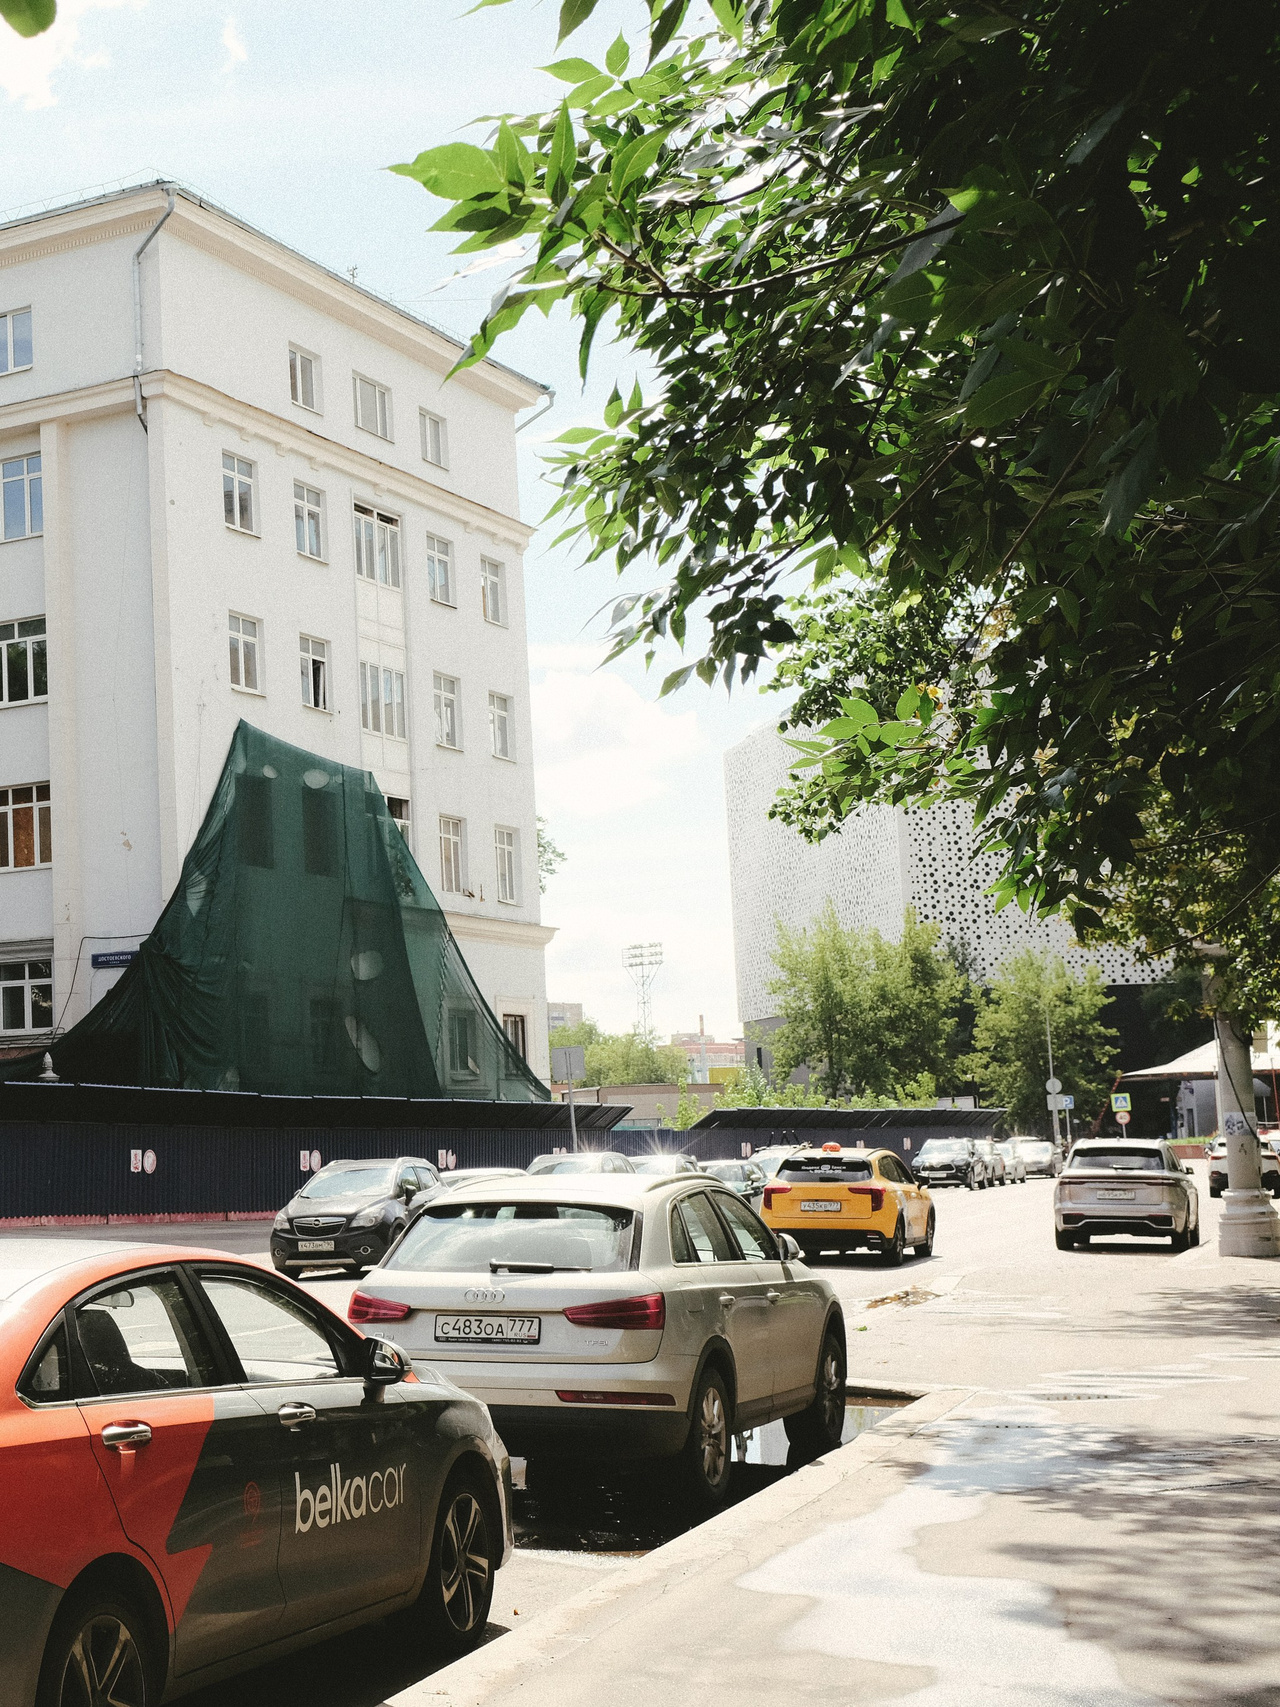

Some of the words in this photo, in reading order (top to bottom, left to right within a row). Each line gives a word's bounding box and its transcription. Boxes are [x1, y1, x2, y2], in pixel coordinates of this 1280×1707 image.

[440, 1318, 505, 1337] С483ОА
[509, 1319, 535, 1333] 777
[294, 1462, 407, 1534] belkacar
